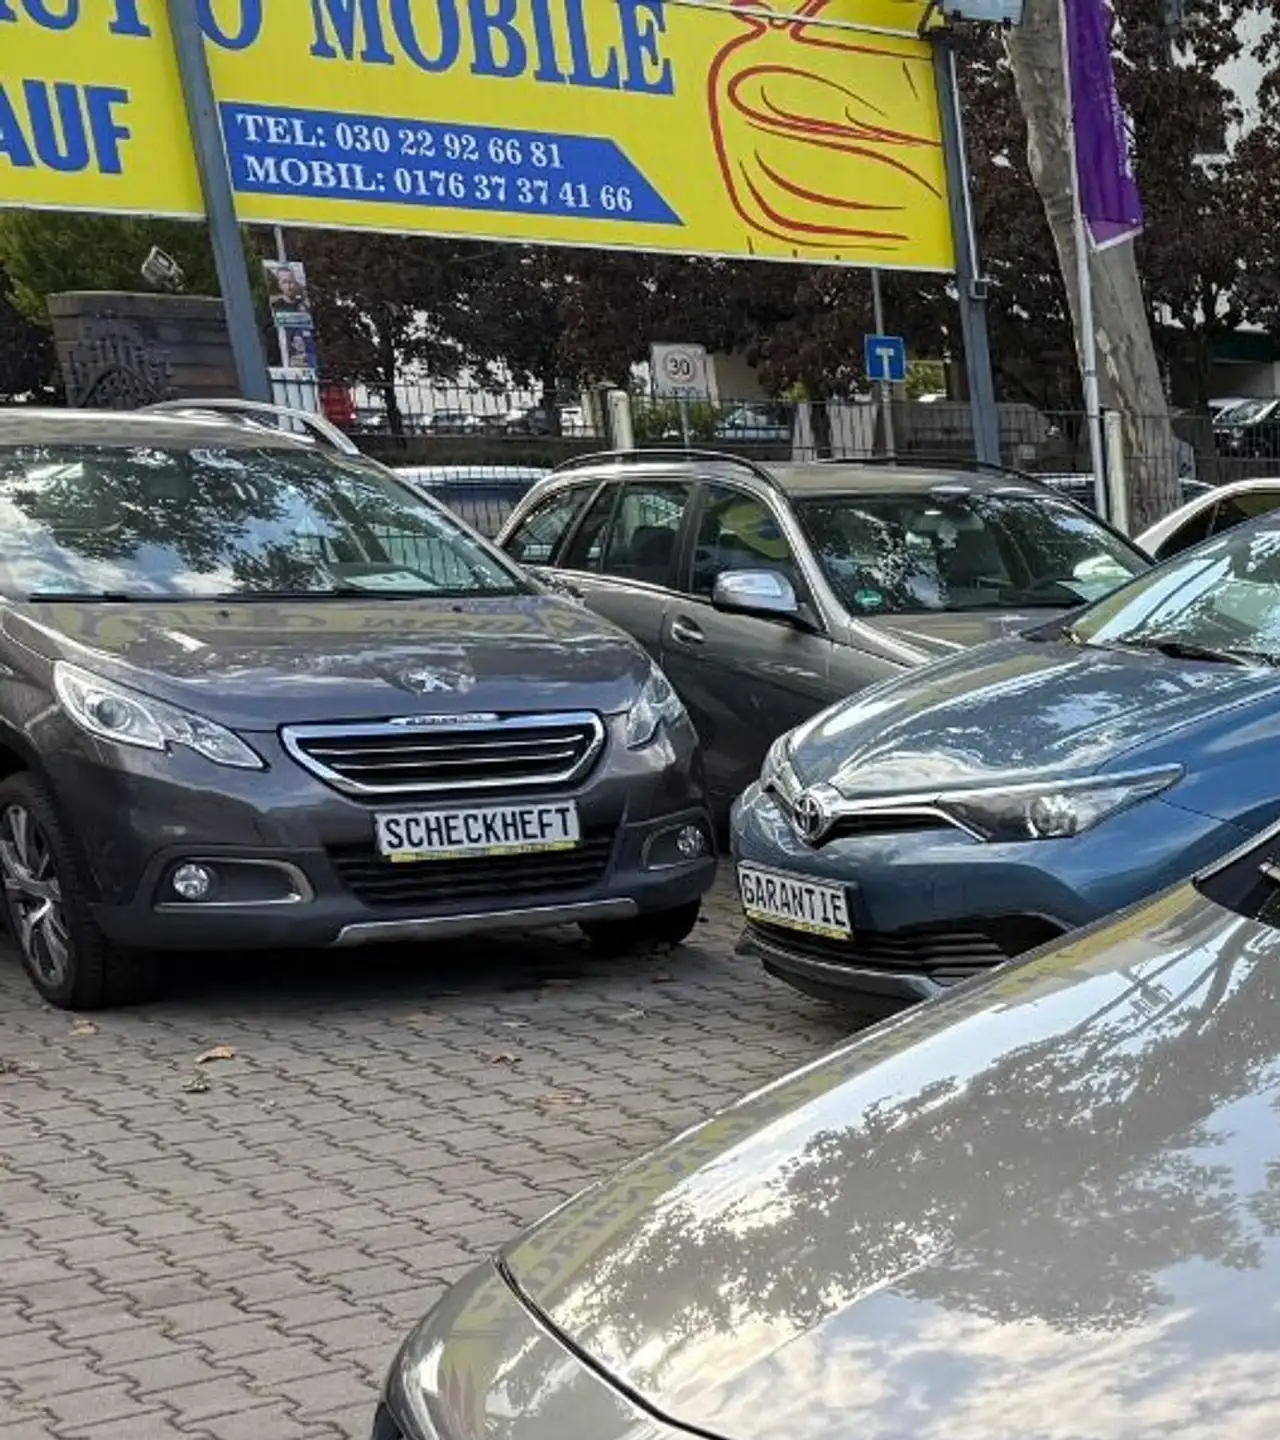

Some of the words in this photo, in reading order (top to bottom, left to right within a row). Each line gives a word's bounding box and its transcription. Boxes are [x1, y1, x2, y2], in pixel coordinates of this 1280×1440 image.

[310, 0, 674, 95] MOBILE
[236, 113, 327, 148] TEL:
[335, 122, 390, 153] 030
[398, 129, 436, 158] 22
[443, 133, 479, 161] 92
[488, 137, 522, 164] 66
[530, 141, 564, 169] 81
[242, 153, 385, 193] MOBIL:
[394, 167, 465, 199] 0176
[473, 172, 506, 202] 37
[517, 177, 548, 206] 37
[559, 182, 591, 208] 41
[600, 184, 633, 212] 66
[669, 357, 690, 376] 30
[384, 807, 571, 849] SCHECKHEFT
[742, 873, 847, 927] GARANTIE
